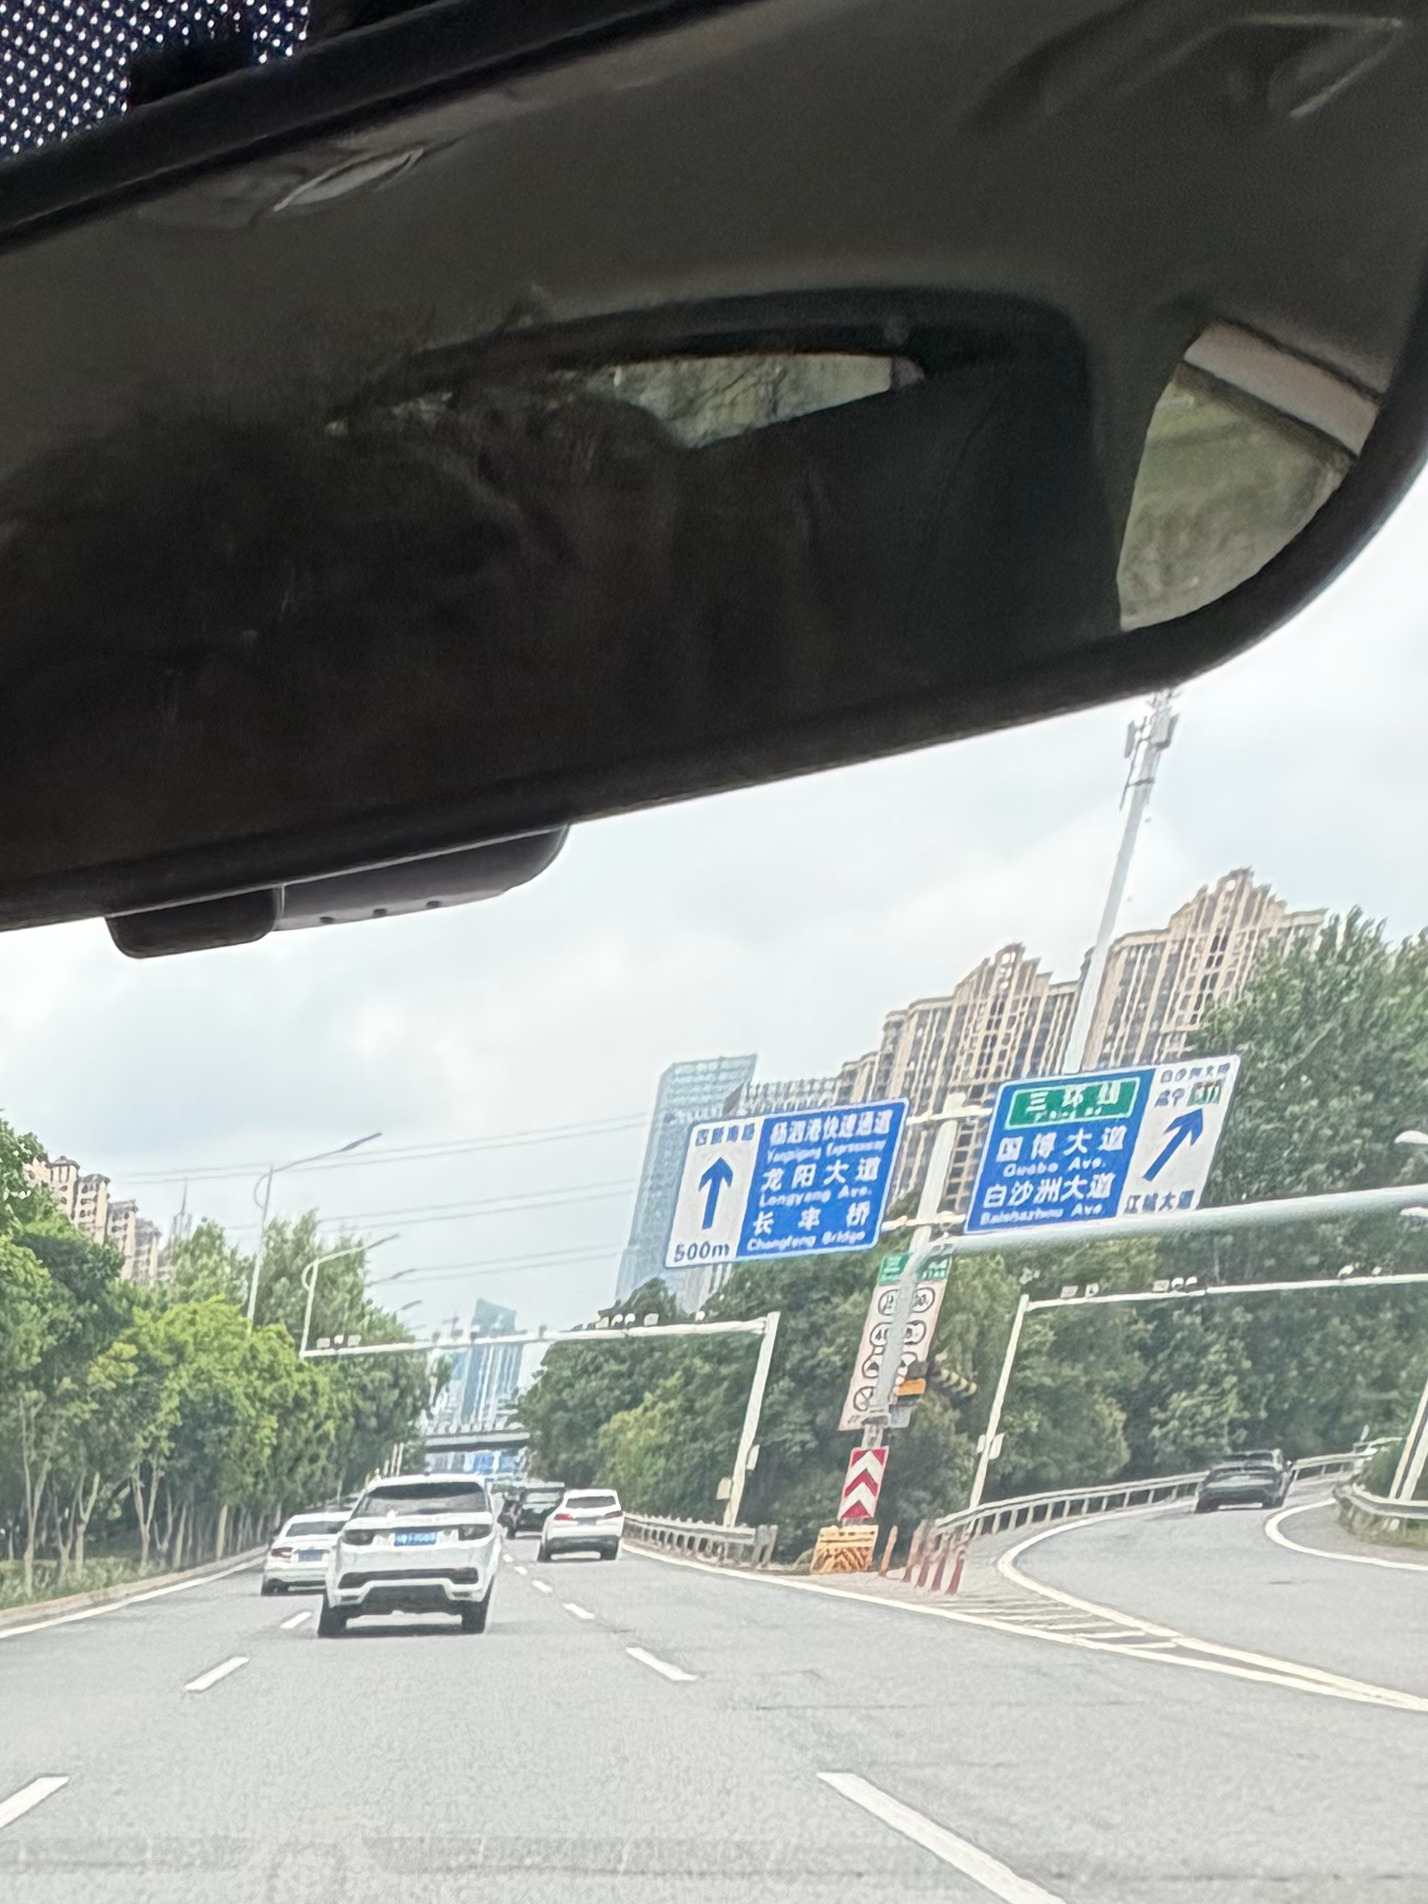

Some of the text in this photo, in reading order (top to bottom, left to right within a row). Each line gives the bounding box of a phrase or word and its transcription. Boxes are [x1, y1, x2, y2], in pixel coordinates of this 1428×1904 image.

[760, 1157, 881, 1192] 龙阳大道
[982, 1172, 1116, 1209] 白沙洲大道
[673, 1240, 730, 1263] 500m
